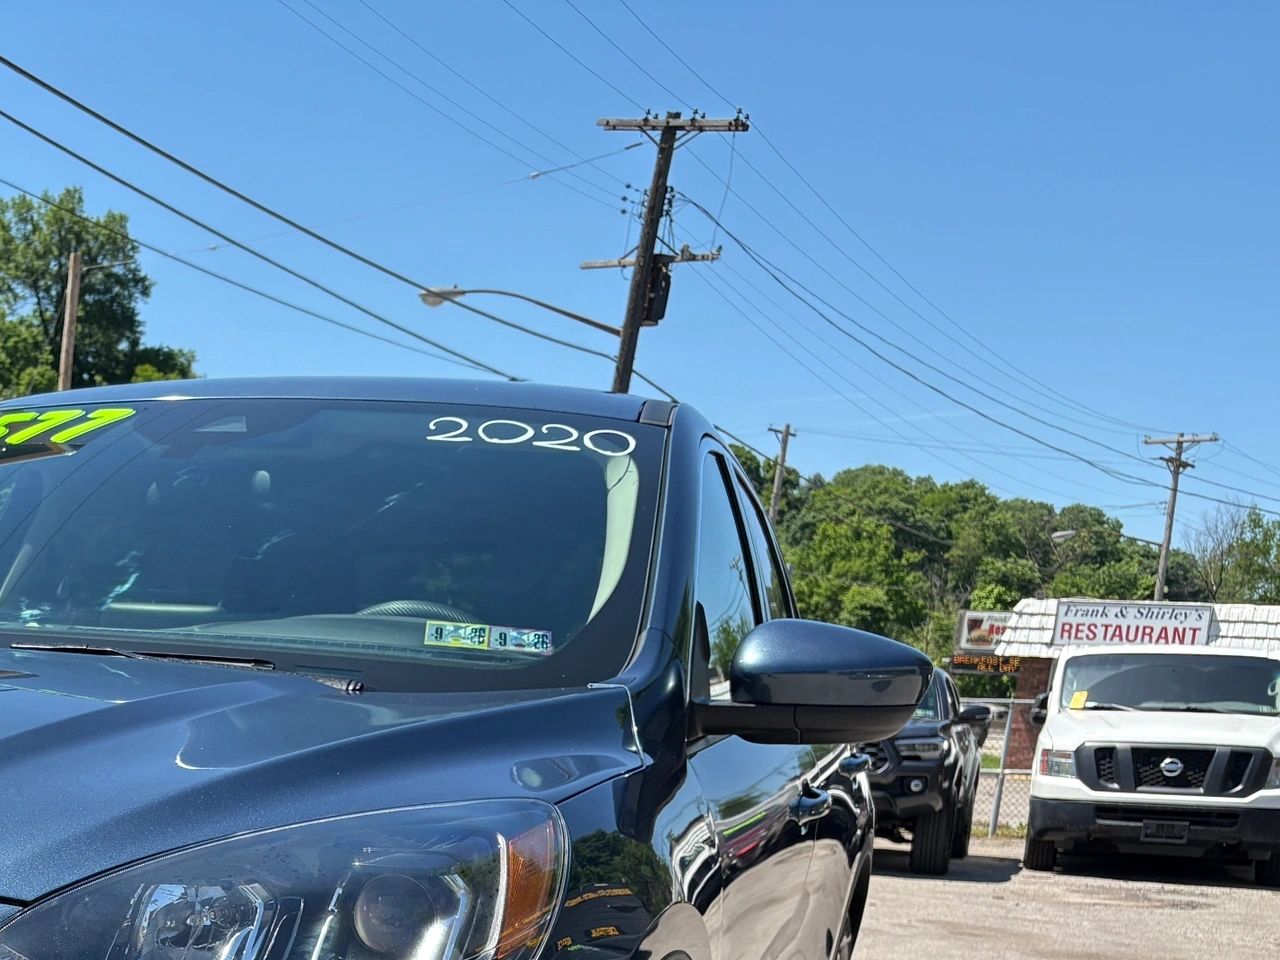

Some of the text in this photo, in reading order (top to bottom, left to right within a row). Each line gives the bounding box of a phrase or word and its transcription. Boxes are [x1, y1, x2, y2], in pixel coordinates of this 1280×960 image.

[426, 416, 636, 456] 2020
[1064, 605, 1204, 624] Frank & Shirley's
[1060, 622, 1201, 645] RESTAURANT
